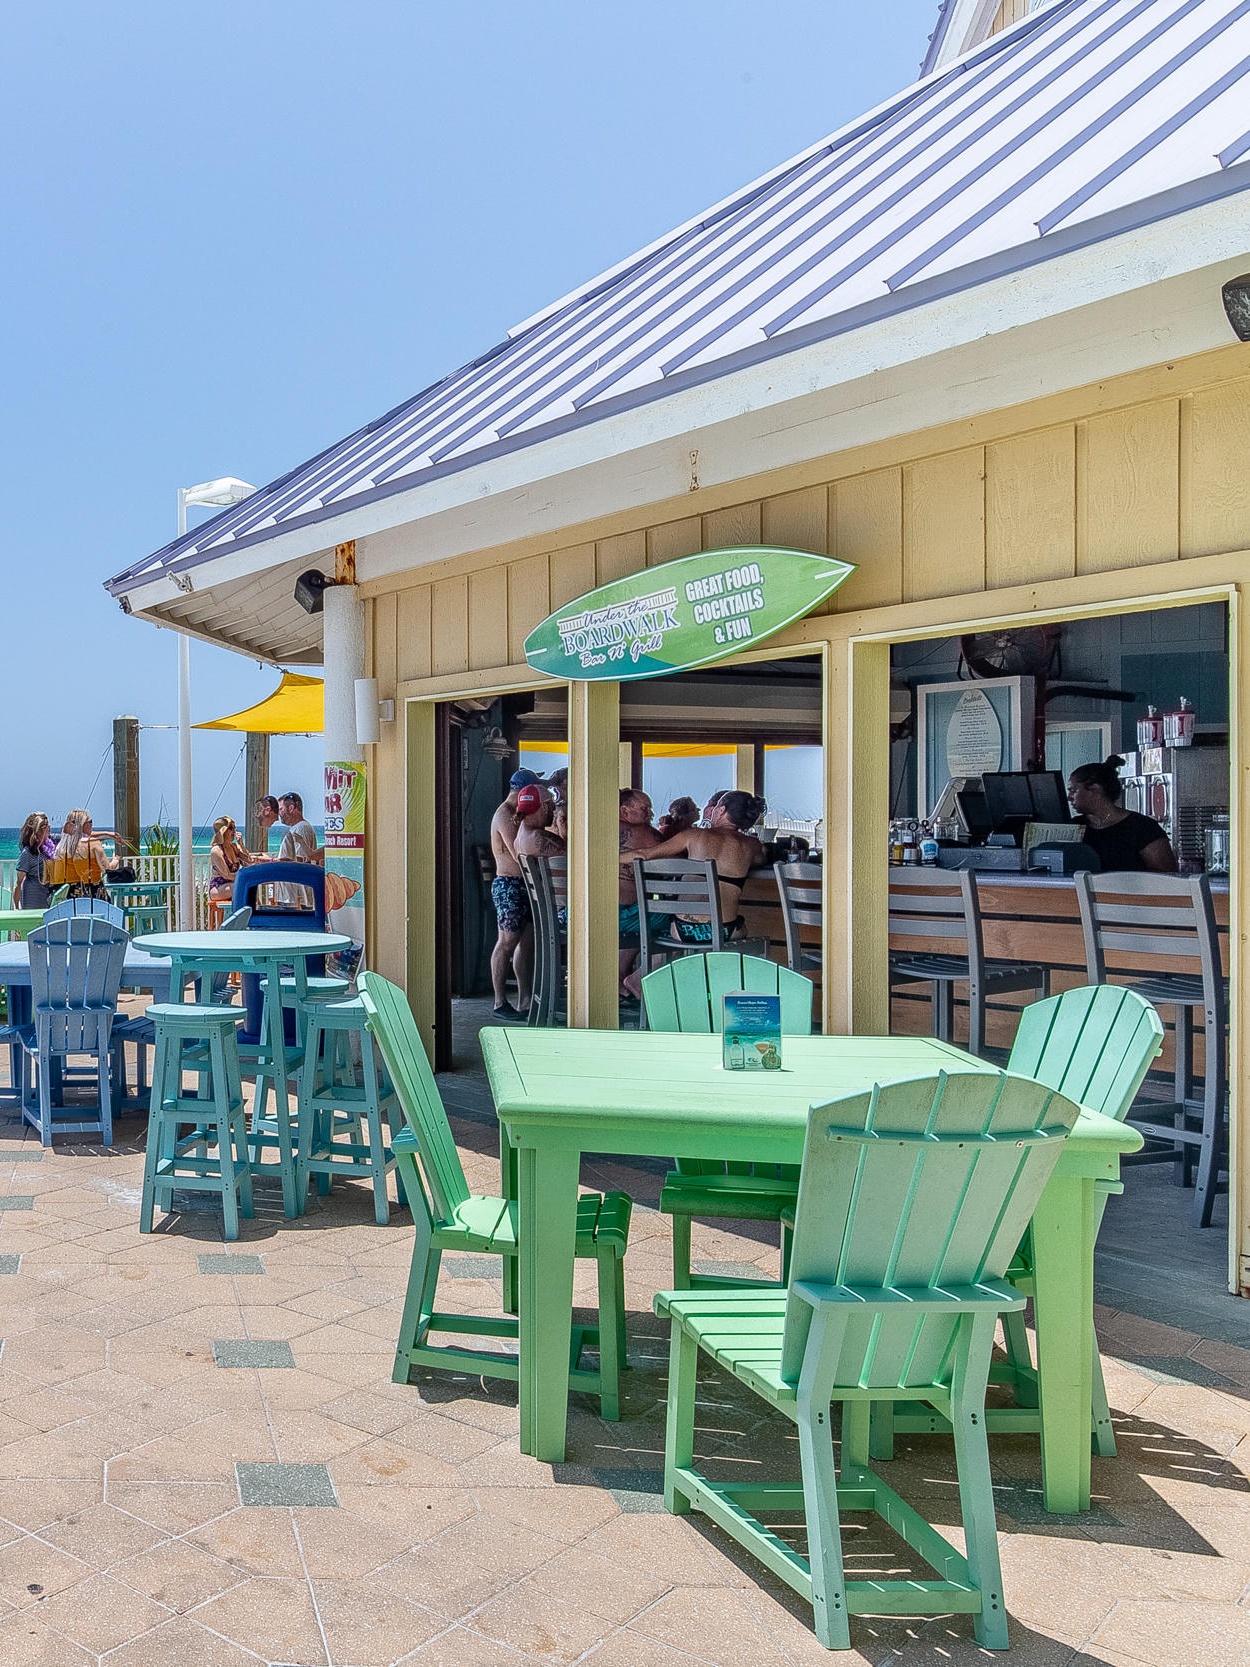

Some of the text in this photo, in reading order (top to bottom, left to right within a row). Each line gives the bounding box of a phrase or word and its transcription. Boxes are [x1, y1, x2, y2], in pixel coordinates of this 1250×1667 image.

[685, 563, 764, 602] GREAT FOOD,
[582, 600, 648, 628] Under the
[693, 587, 764, 625] COCKTAILS
[563, 607, 679, 654] BOARDWALK
[714, 615, 752, 644] & FUN
[580, 653, 605, 666] Bar
[630, 633, 663, 661] Grill
[337, 835, 357, 847] Resort
